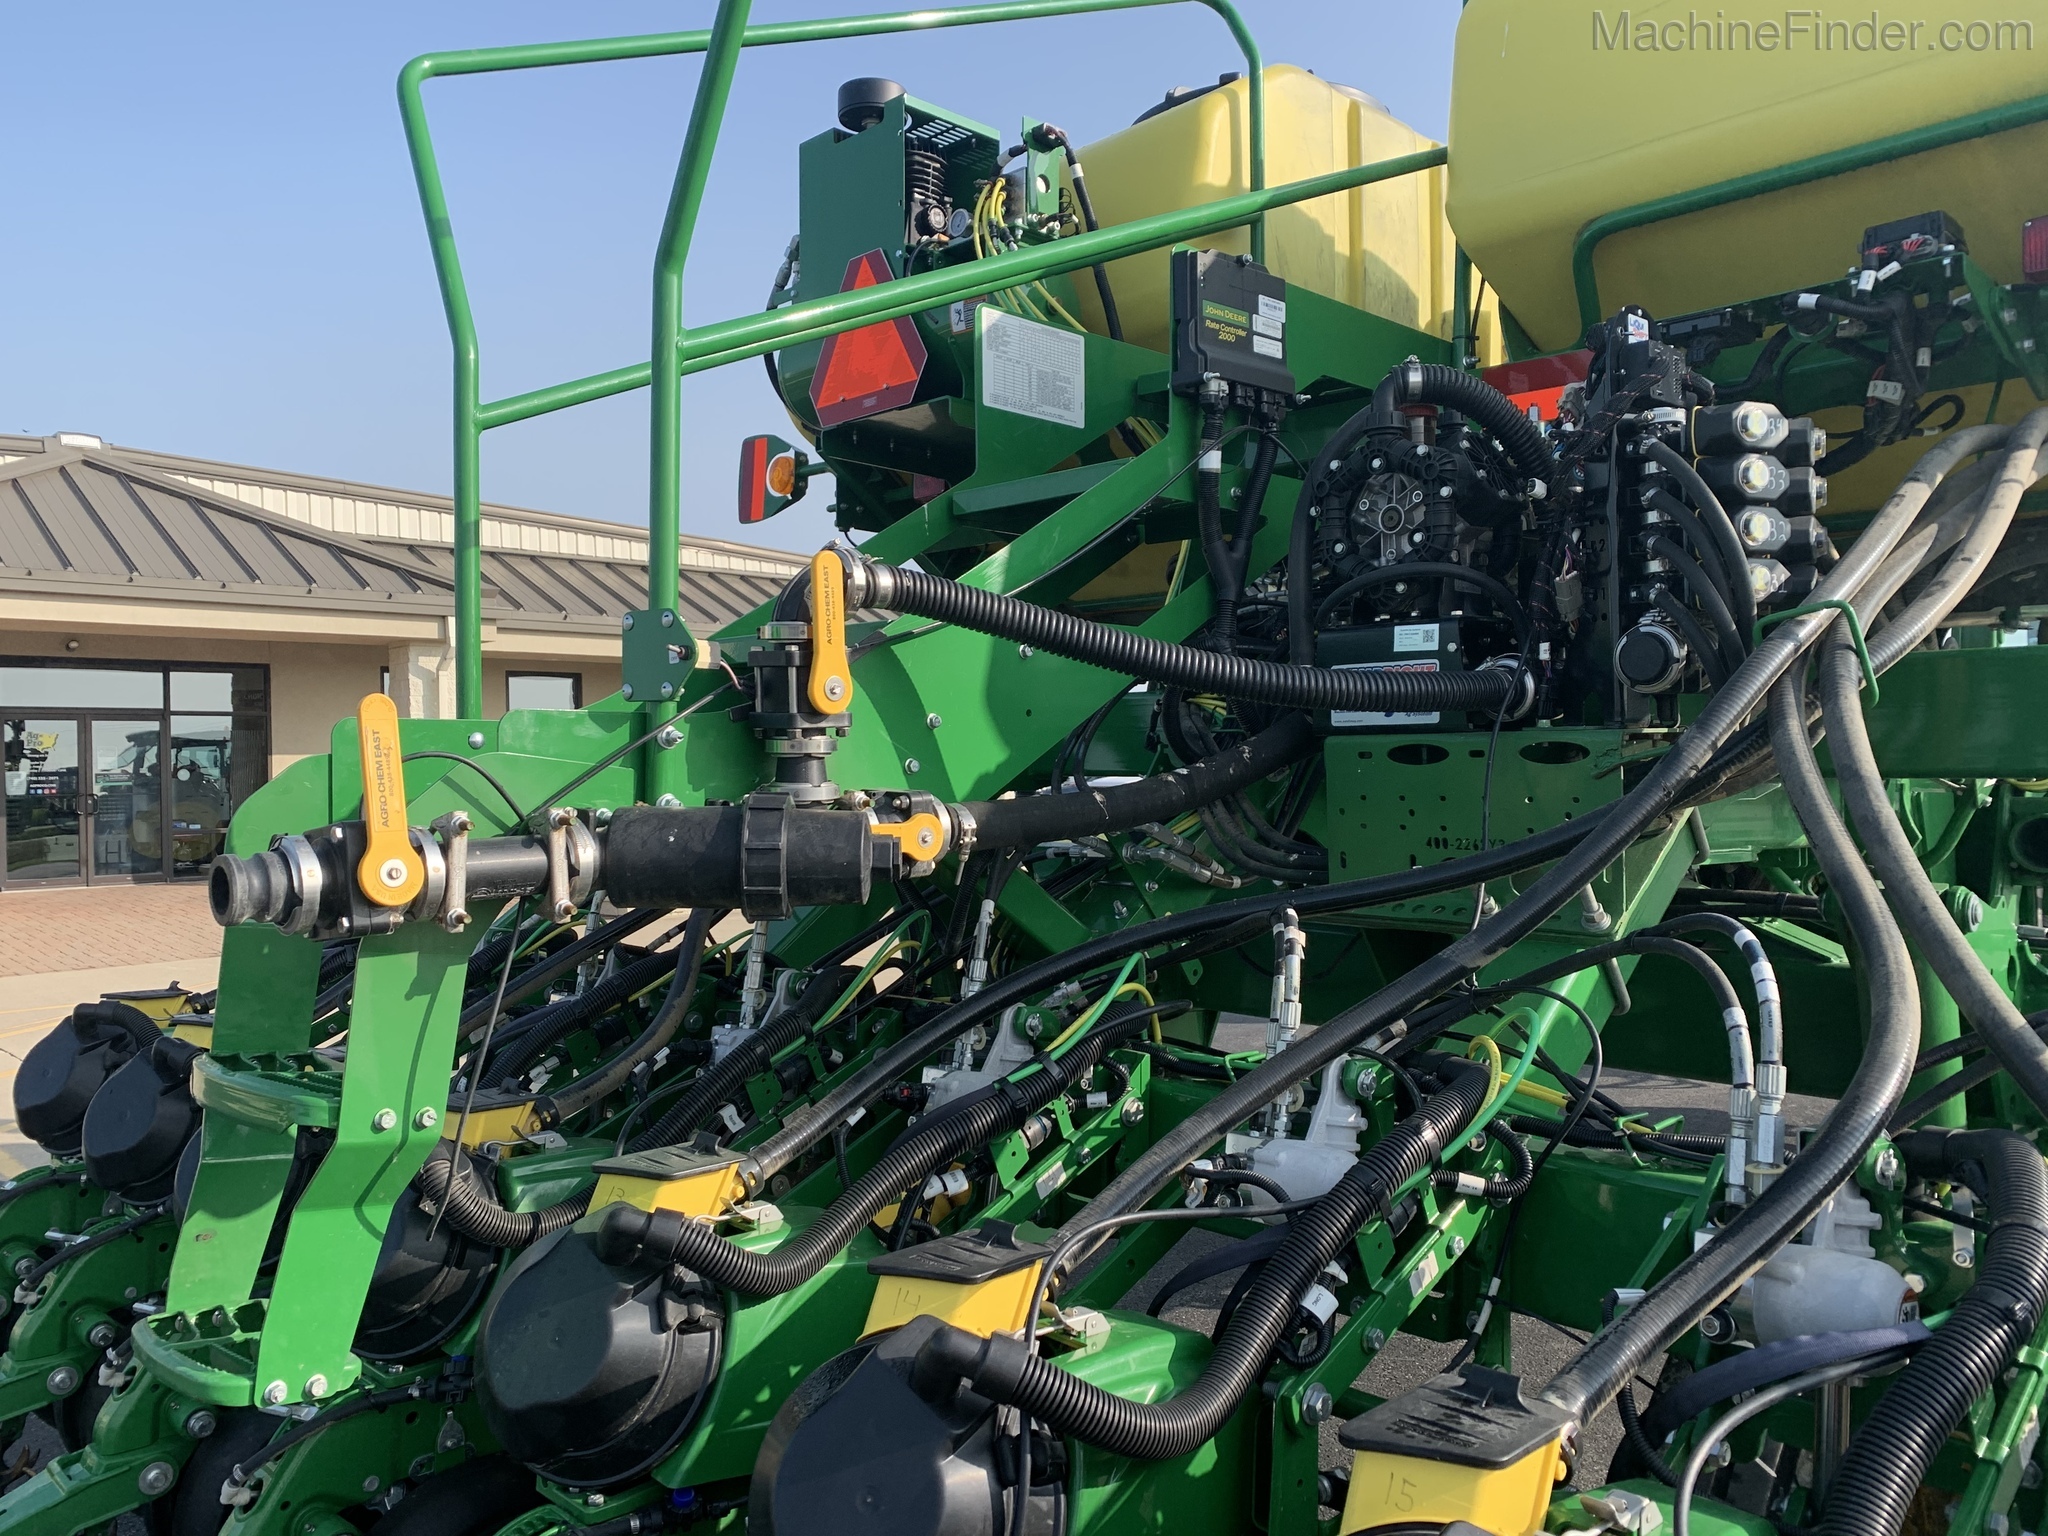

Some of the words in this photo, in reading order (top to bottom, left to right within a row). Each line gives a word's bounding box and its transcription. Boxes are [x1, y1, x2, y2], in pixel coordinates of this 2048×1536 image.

[1206, 304, 1224, 316] JOHN
[1224, 310, 1247, 324] DEERE
[1205, 319, 1220, 330] Rate
[1220, 323, 1248, 337] Controller
[1218, 331, 1236, 342] 2000
[822, 564, 830, 589] EAST
[372, 729, 384, 758] EAST
[892, 1287, 921, 1316] 14
[1384, 1472, 1417, 1513] 15
